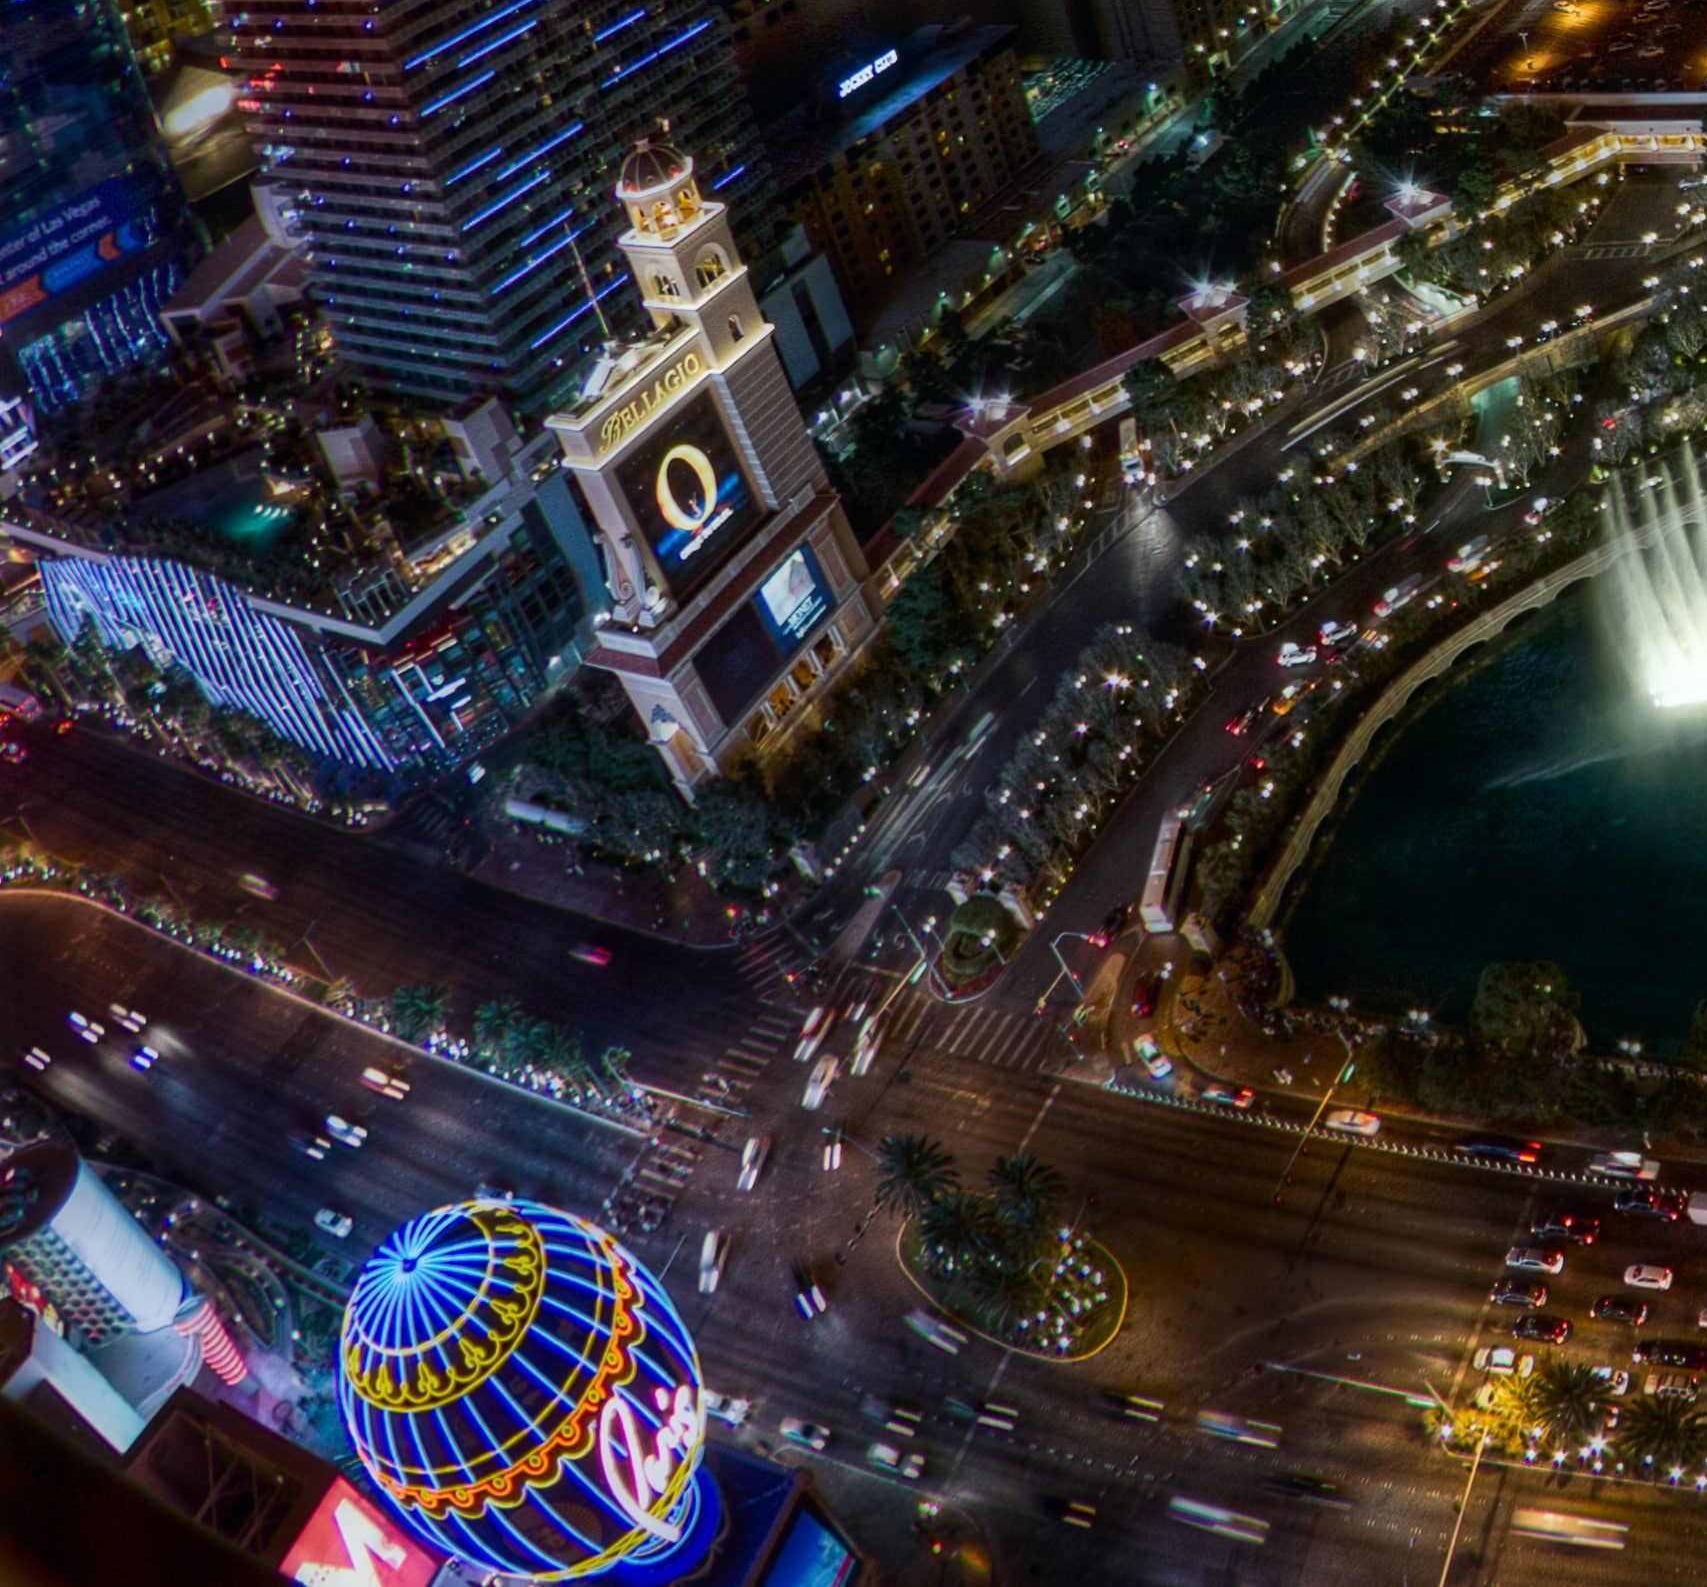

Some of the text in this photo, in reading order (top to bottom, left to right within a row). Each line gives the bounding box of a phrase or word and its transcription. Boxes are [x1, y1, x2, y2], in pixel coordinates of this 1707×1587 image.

[41, 217, 64, 234] Las
[62, 197, 101, 220] Vegas
[600, 352, 700, 452] BELLAGIO
[656, 445, 717, 531] O
[600, 1384, 698, 1542] Paris
